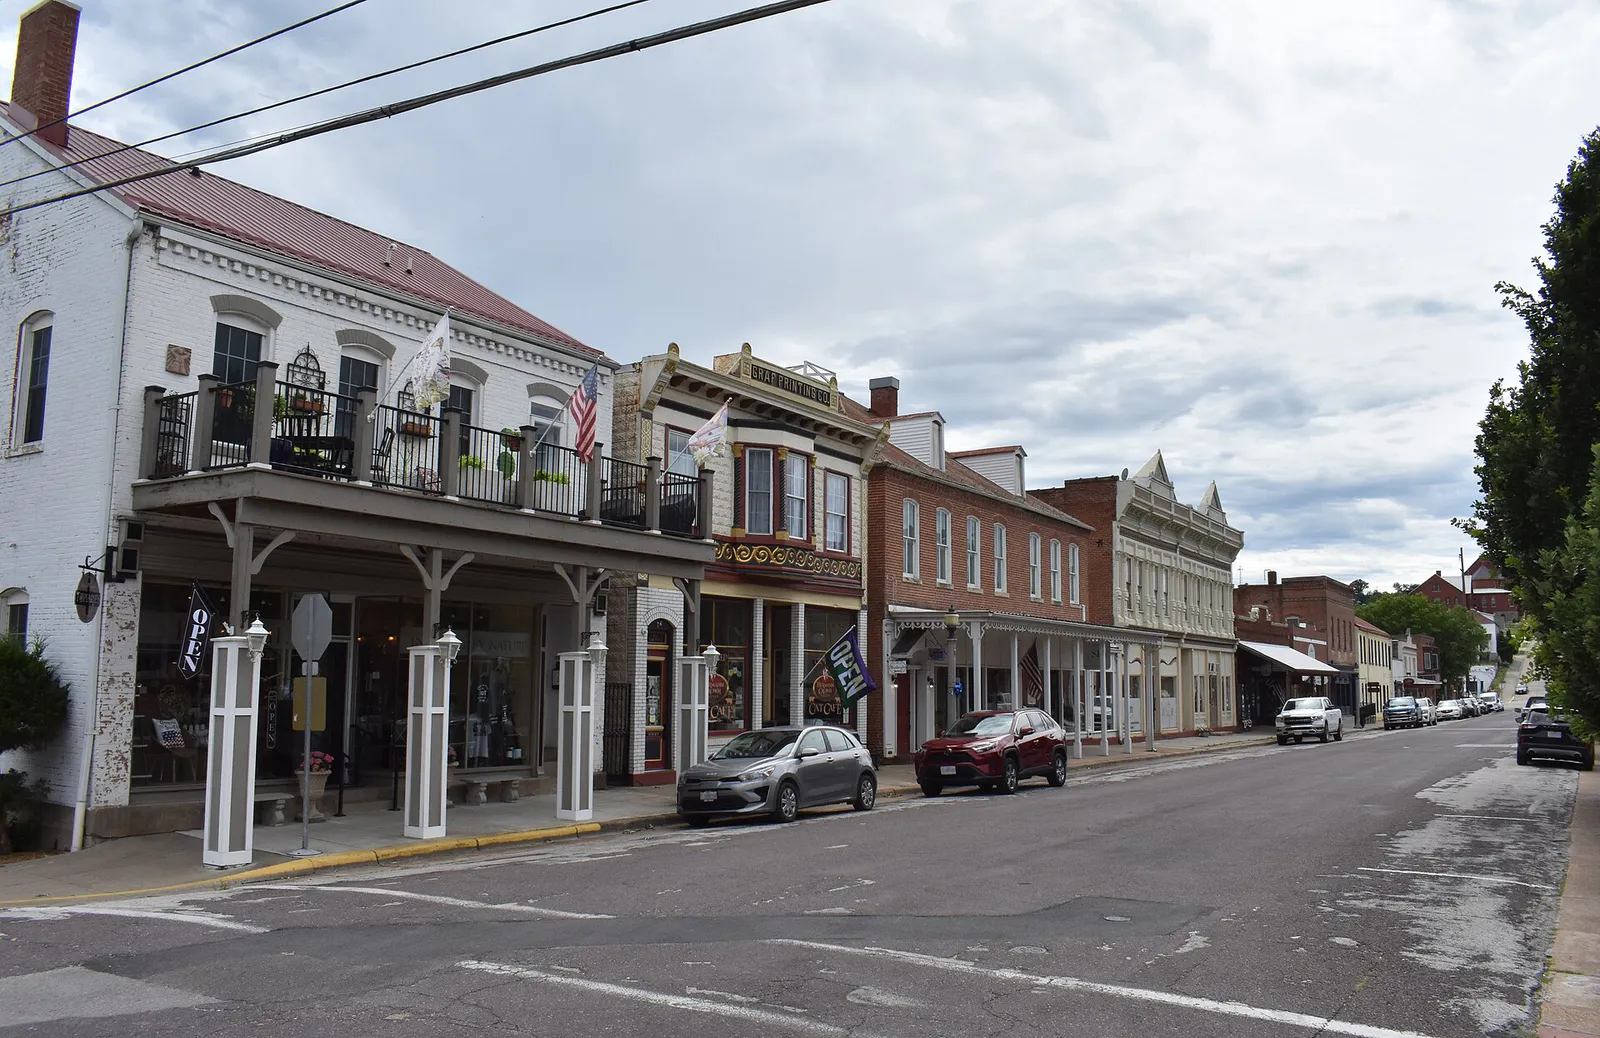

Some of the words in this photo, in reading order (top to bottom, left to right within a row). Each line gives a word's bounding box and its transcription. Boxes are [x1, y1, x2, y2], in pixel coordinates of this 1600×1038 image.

[752, 366, 776, 384] GRAF
[778, 375, 816, 398] PRINTING
[818, 390, 830, 404] CO.
[182, 609, 208, 672] OPEN
[830, 640, 867, 699] OPEN
[268, 702, 276, 742] OPEN
